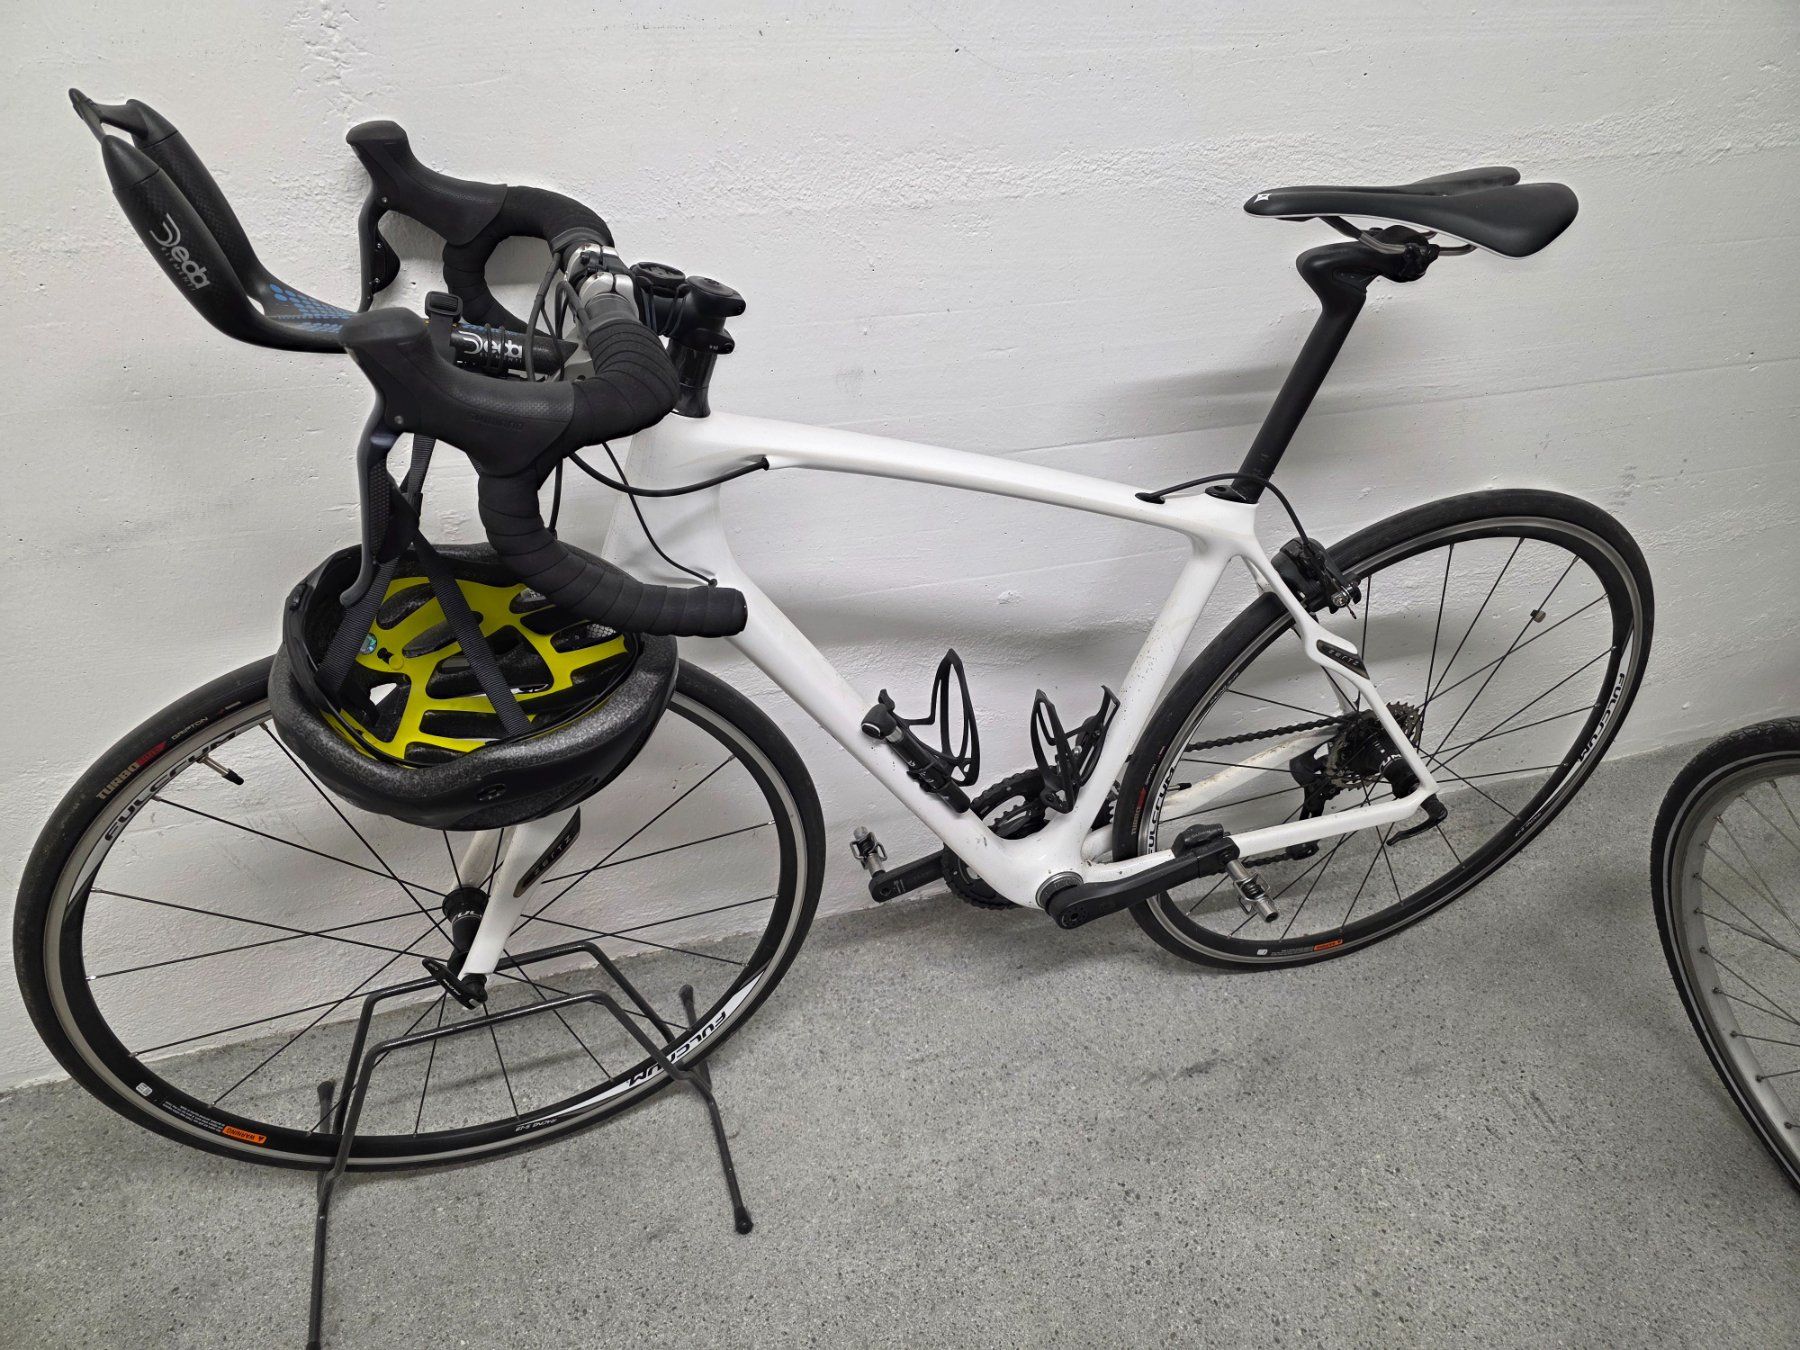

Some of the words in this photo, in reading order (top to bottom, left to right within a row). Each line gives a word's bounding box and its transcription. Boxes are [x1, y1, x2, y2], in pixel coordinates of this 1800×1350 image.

[149, 212, 211, 289] Deda
[1579, 673, 1625, 761] FULCRUM
[95, 761, 141, 800] TURBO
[227, 1127, 255, 1140] WARNING
